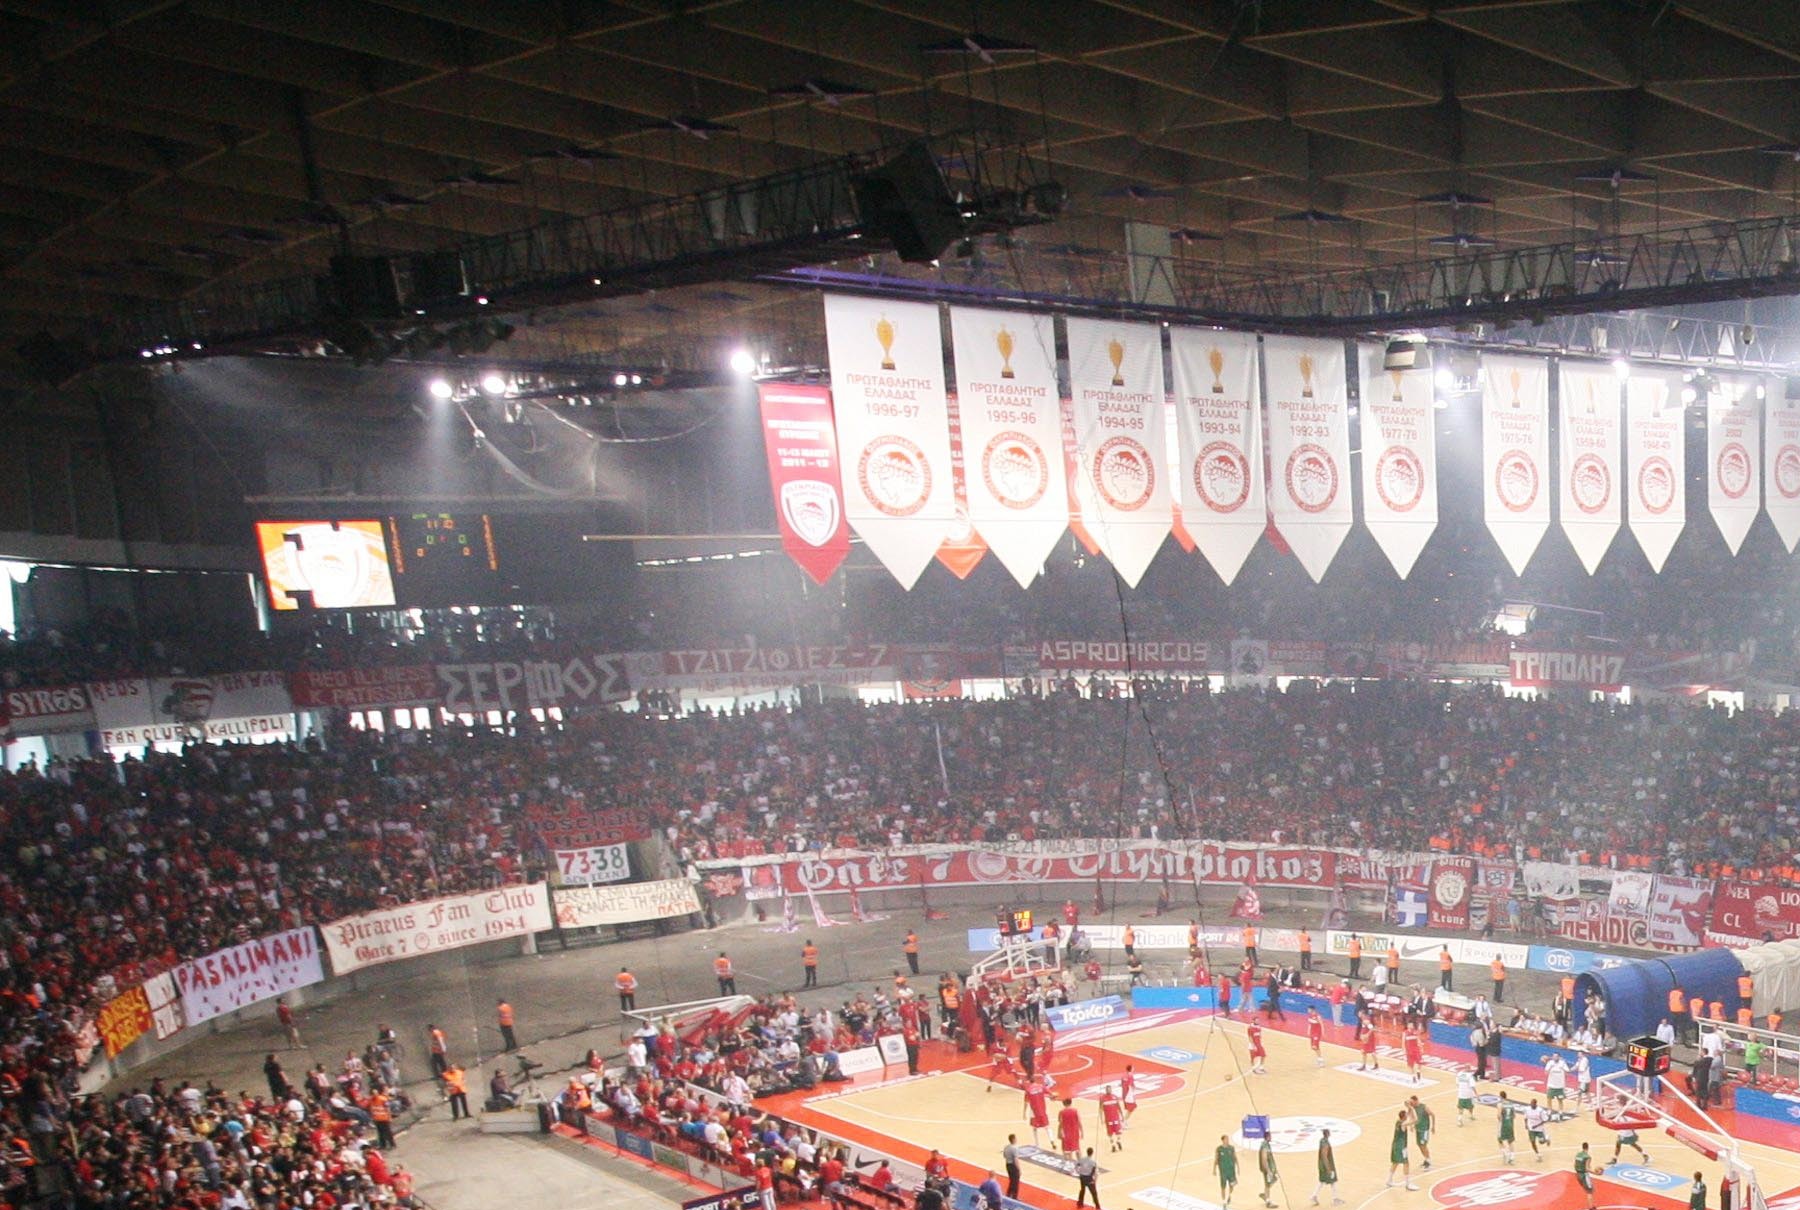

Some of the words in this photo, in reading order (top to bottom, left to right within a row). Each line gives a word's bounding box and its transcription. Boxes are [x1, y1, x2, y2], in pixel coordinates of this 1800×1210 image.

[847, 374, 932, 389] ΠΡΩΤΑΘΛΗΤΗΣ
[865, 388, 917, 400] ΕΛΛΑΔΑΣ
[970, 382, 1047, 397] ΠΡΩΤΑΘΛΗΤΗΣ
[1083, 390, 1152, 403] ΠΡΩΤΑΘΛΗΤΗΣ
[987, 395, 1032, 407] ΕΛΛΑΔΑΣ
[1100, 402, 1142, 413] ΕΛΛΑΔΑΣ
[866, 403, 919, 418] 1996-97
[987, 410, 1036, 424] 1995-96
[1100, 416, 1144, 429] 1994-95
[1200, 422, 1240, 434] 1993-94
[1291, 425, 1330, 437] 1992-93
[310, 670, 348, 687] RED
[104, 729, 137, 744] FAN
[558, 846, 624, 876] 73-38
[799, 858, 912, 888] Gate
[925, 853, 951, 881] 7
[1727, 886, 1750, 900] NEA
[338, 913, 417, 948] Piraeus
[427, 902, 471, 929] Fan
[485, 888, 536, 914] Club
[1723, 912, 1742, 928] CL
[437, 926, 478, 945] since
[484, 915, 526, 937] 1984
[1547, 954, 1573, 968] OTE
